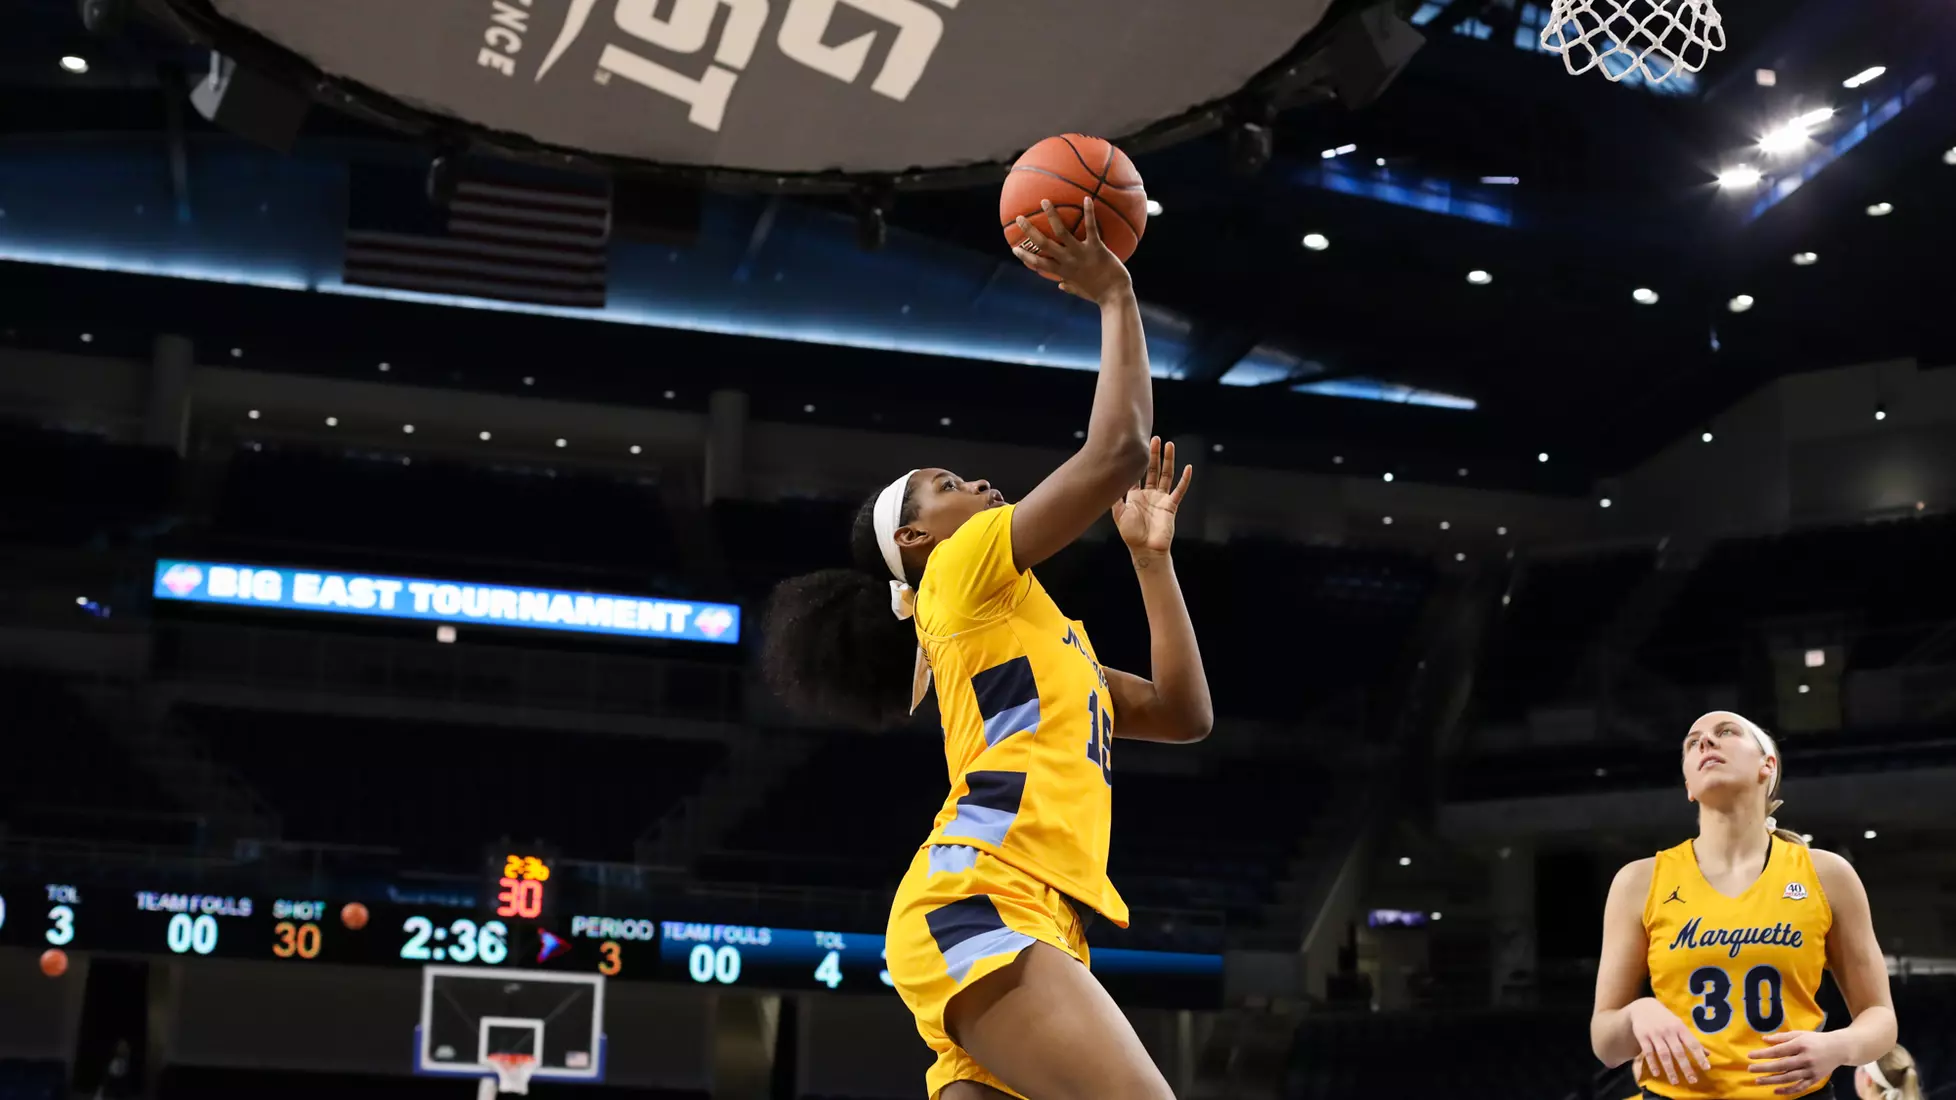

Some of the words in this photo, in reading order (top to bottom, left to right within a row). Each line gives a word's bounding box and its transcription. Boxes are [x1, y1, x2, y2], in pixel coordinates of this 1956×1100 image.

[477, 0, 533, 77] NCE
[207, 566, 283, 602] BIG
[292, 573, 403, 611] EAST
[408, 582, 694, 634] TOURNAMENT
[46, 884, 79, 904] TOL
[136, 890, 188, 914] TEAM
[189, 893, 253, 917] FOULS
[272, 898, 326, 921] SHOT
[496, 877, 544, 918] 30
[45, 905, 75, 946] 3
[167, 913, 219, 954] 00
[272, 921, 322, 959] 30
[400, 915, 509, 965] 2:36
[571, 915, 655, 941] PERIOD
[662, 921, 712, 943] TEAM
[712, 924, 772, 946] FOULS
[814, 930, 846, 950] TOL
[1669, 916, 1804, 959] Marquette
[598, 940, 623, 977] 3
[688, 943, 742, 984] 00
[814, 950, 844, 988] 4
[1688, 962, 1785, 1035] 30
